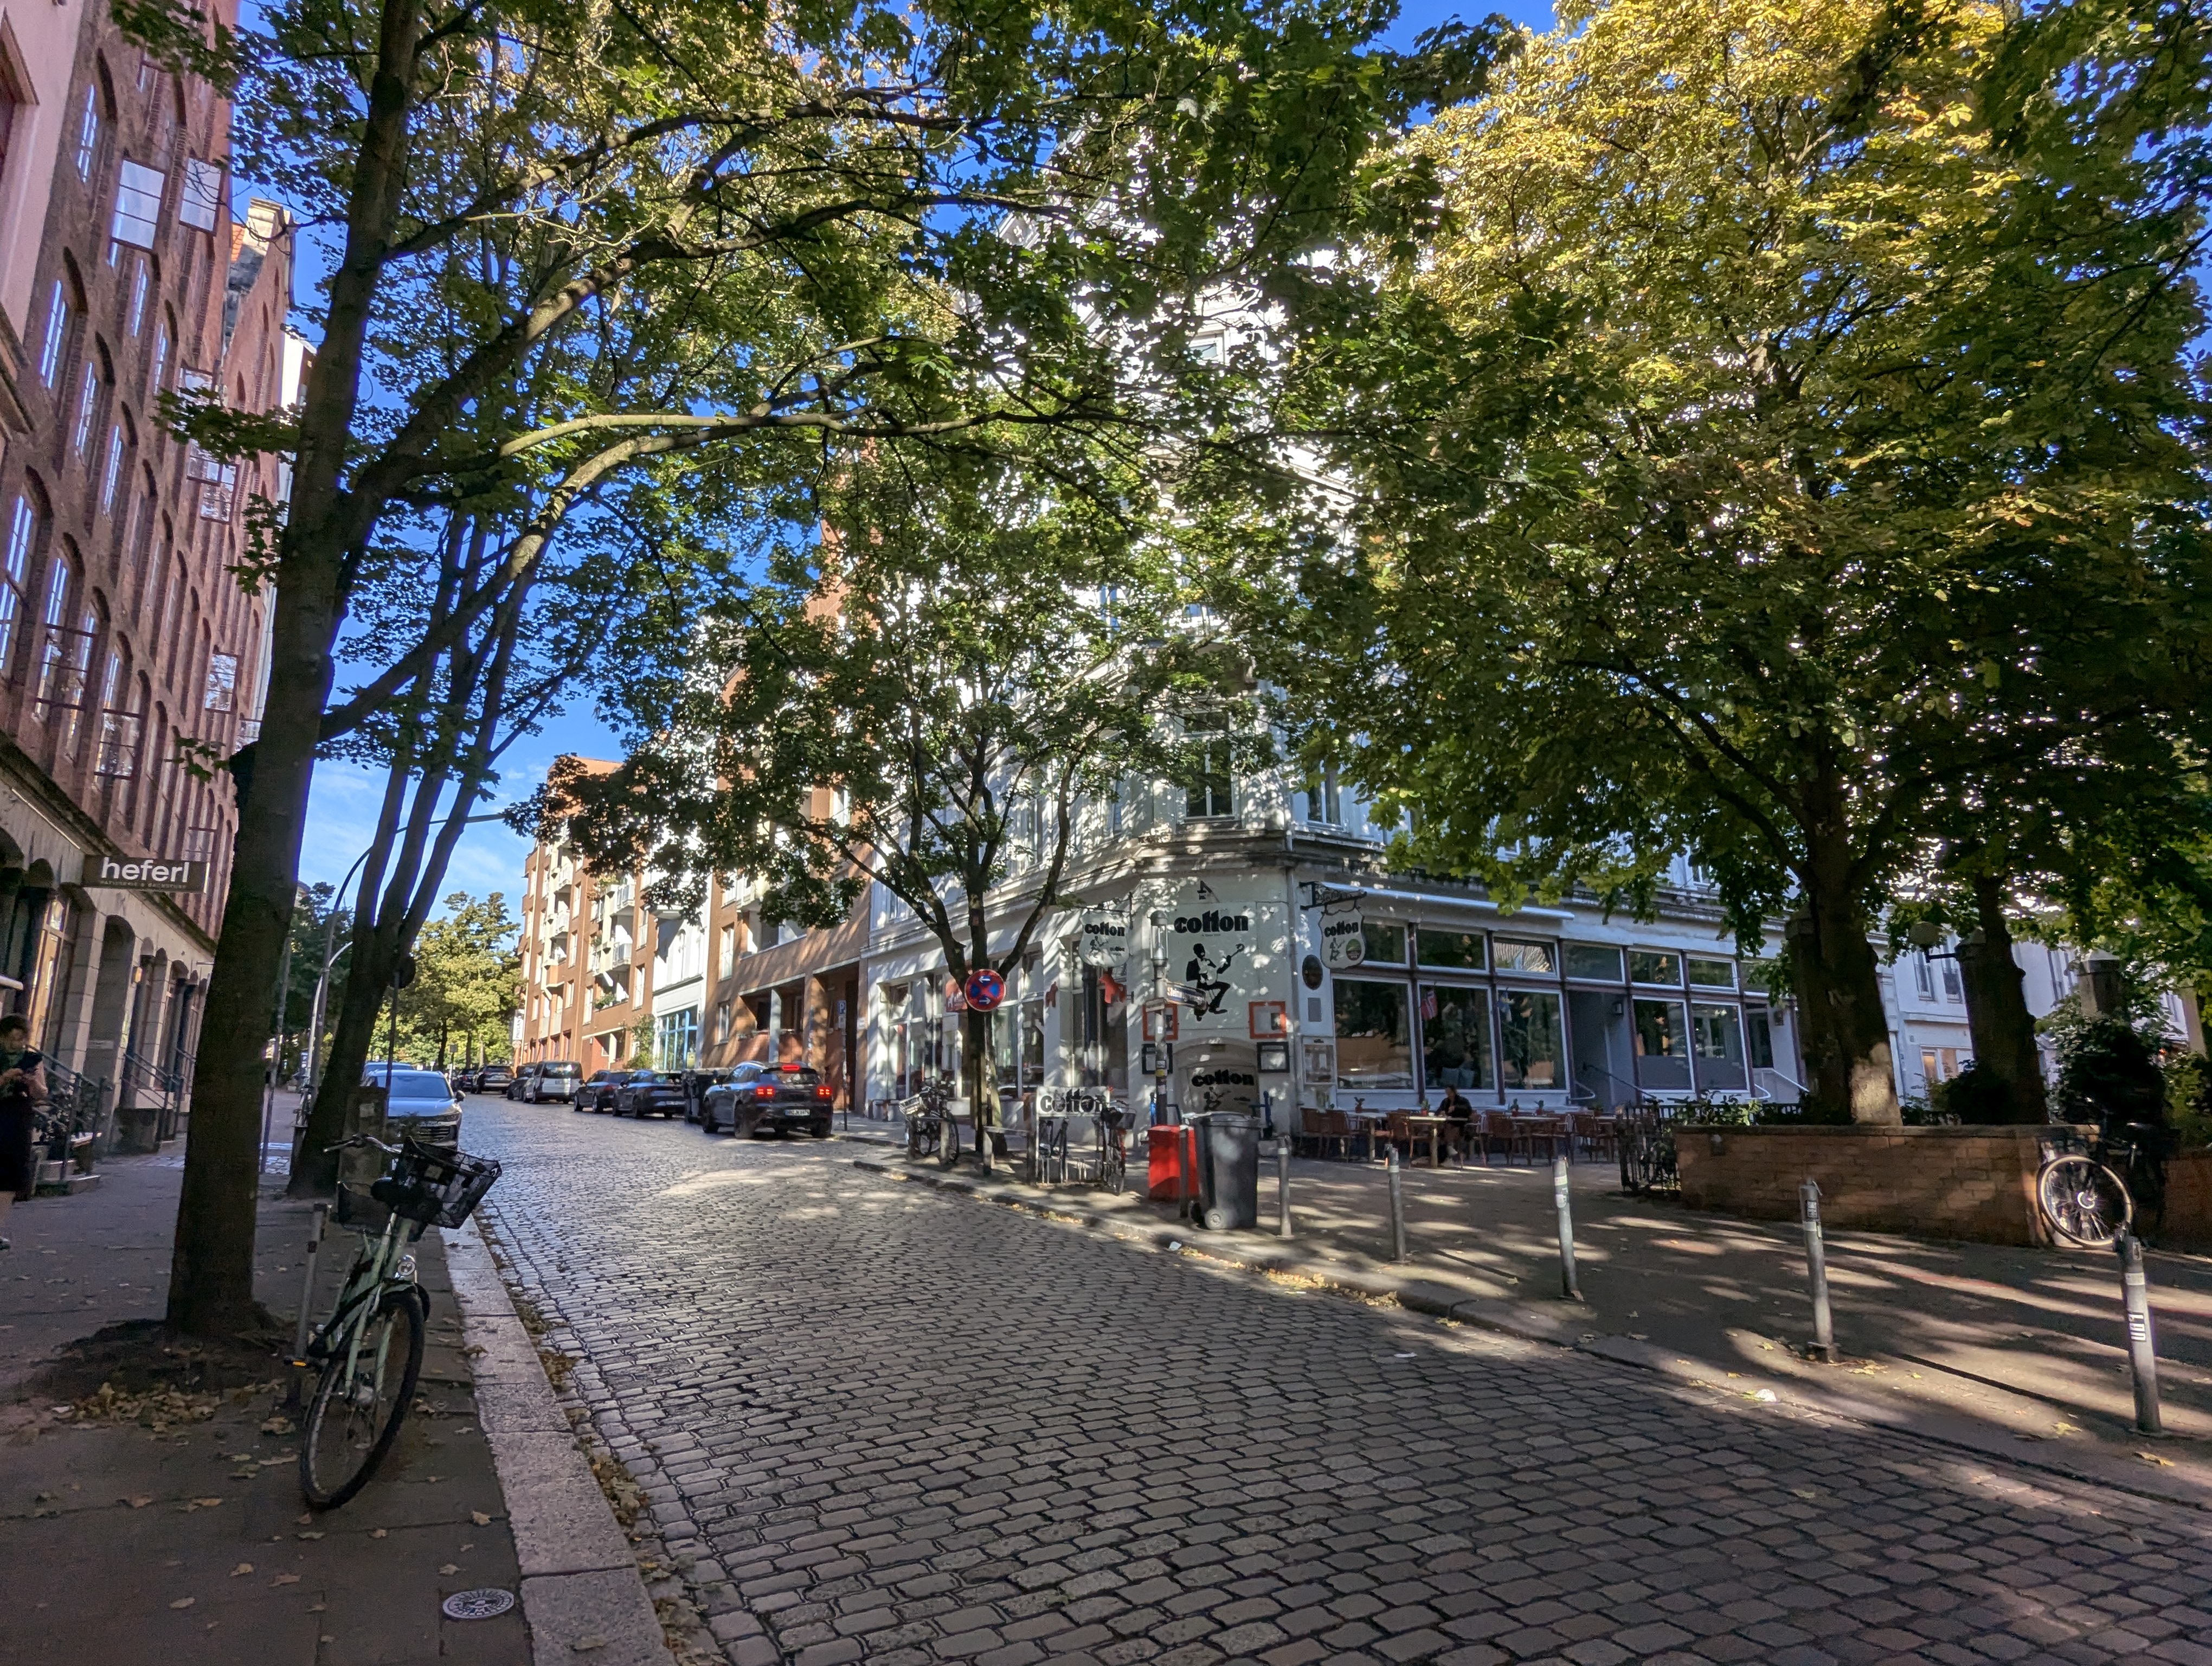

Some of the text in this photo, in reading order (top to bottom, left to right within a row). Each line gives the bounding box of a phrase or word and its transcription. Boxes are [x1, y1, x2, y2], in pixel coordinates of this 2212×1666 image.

[101, 857, 190, 883] heferl
[1084, 921, 1125, 937] cotton
[1174, 910, 1249, 933] cotton
[1324, 921, 1359, 938] cotton
[1192, 1069, 1255, 1087] cotton
